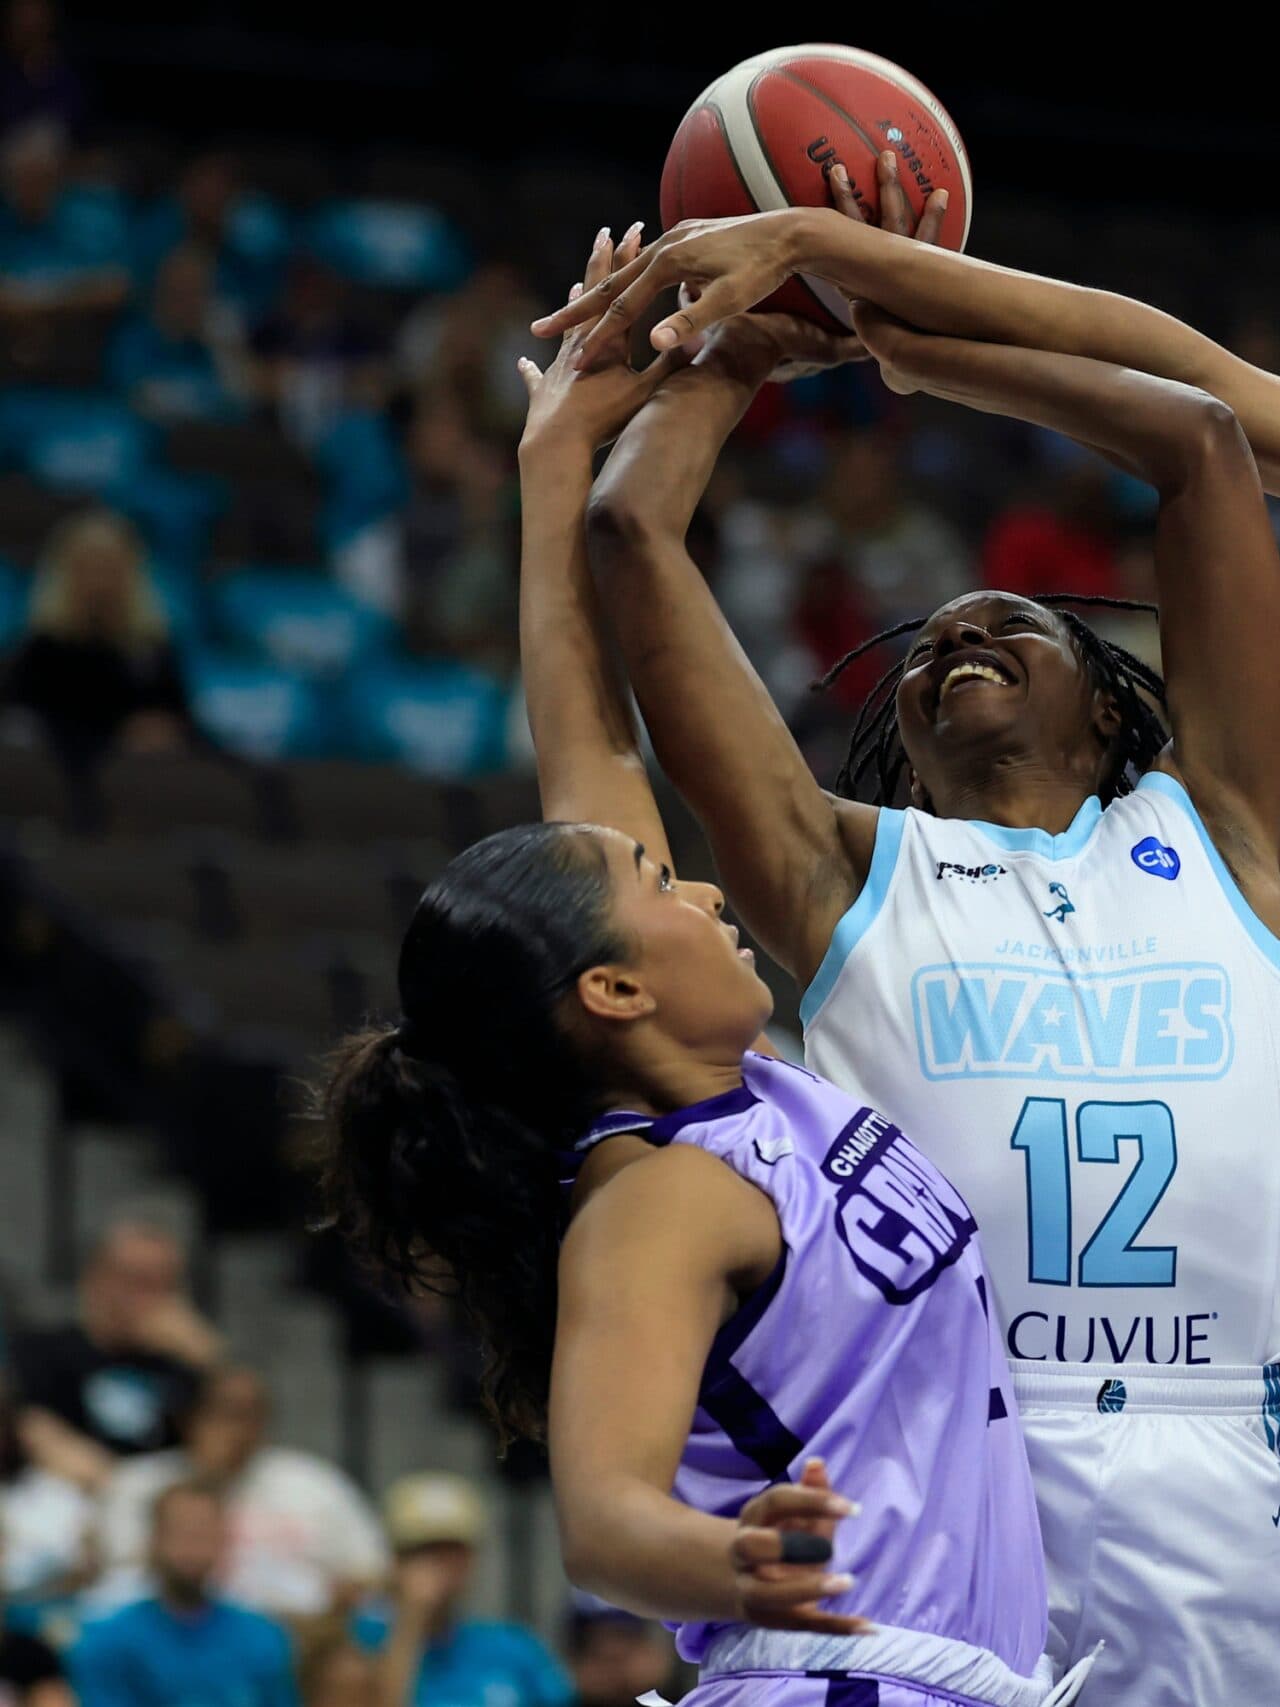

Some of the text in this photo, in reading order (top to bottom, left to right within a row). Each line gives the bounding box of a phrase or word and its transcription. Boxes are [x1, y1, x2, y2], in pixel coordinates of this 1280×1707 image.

[995, 935, 1159, 963] JACKONVILLE
[923, 977, 1224, 1068] WAVES
[1010, 1096, 1178, 1287] 12
[1006, 1311, 1211, 1365] CUVUE
